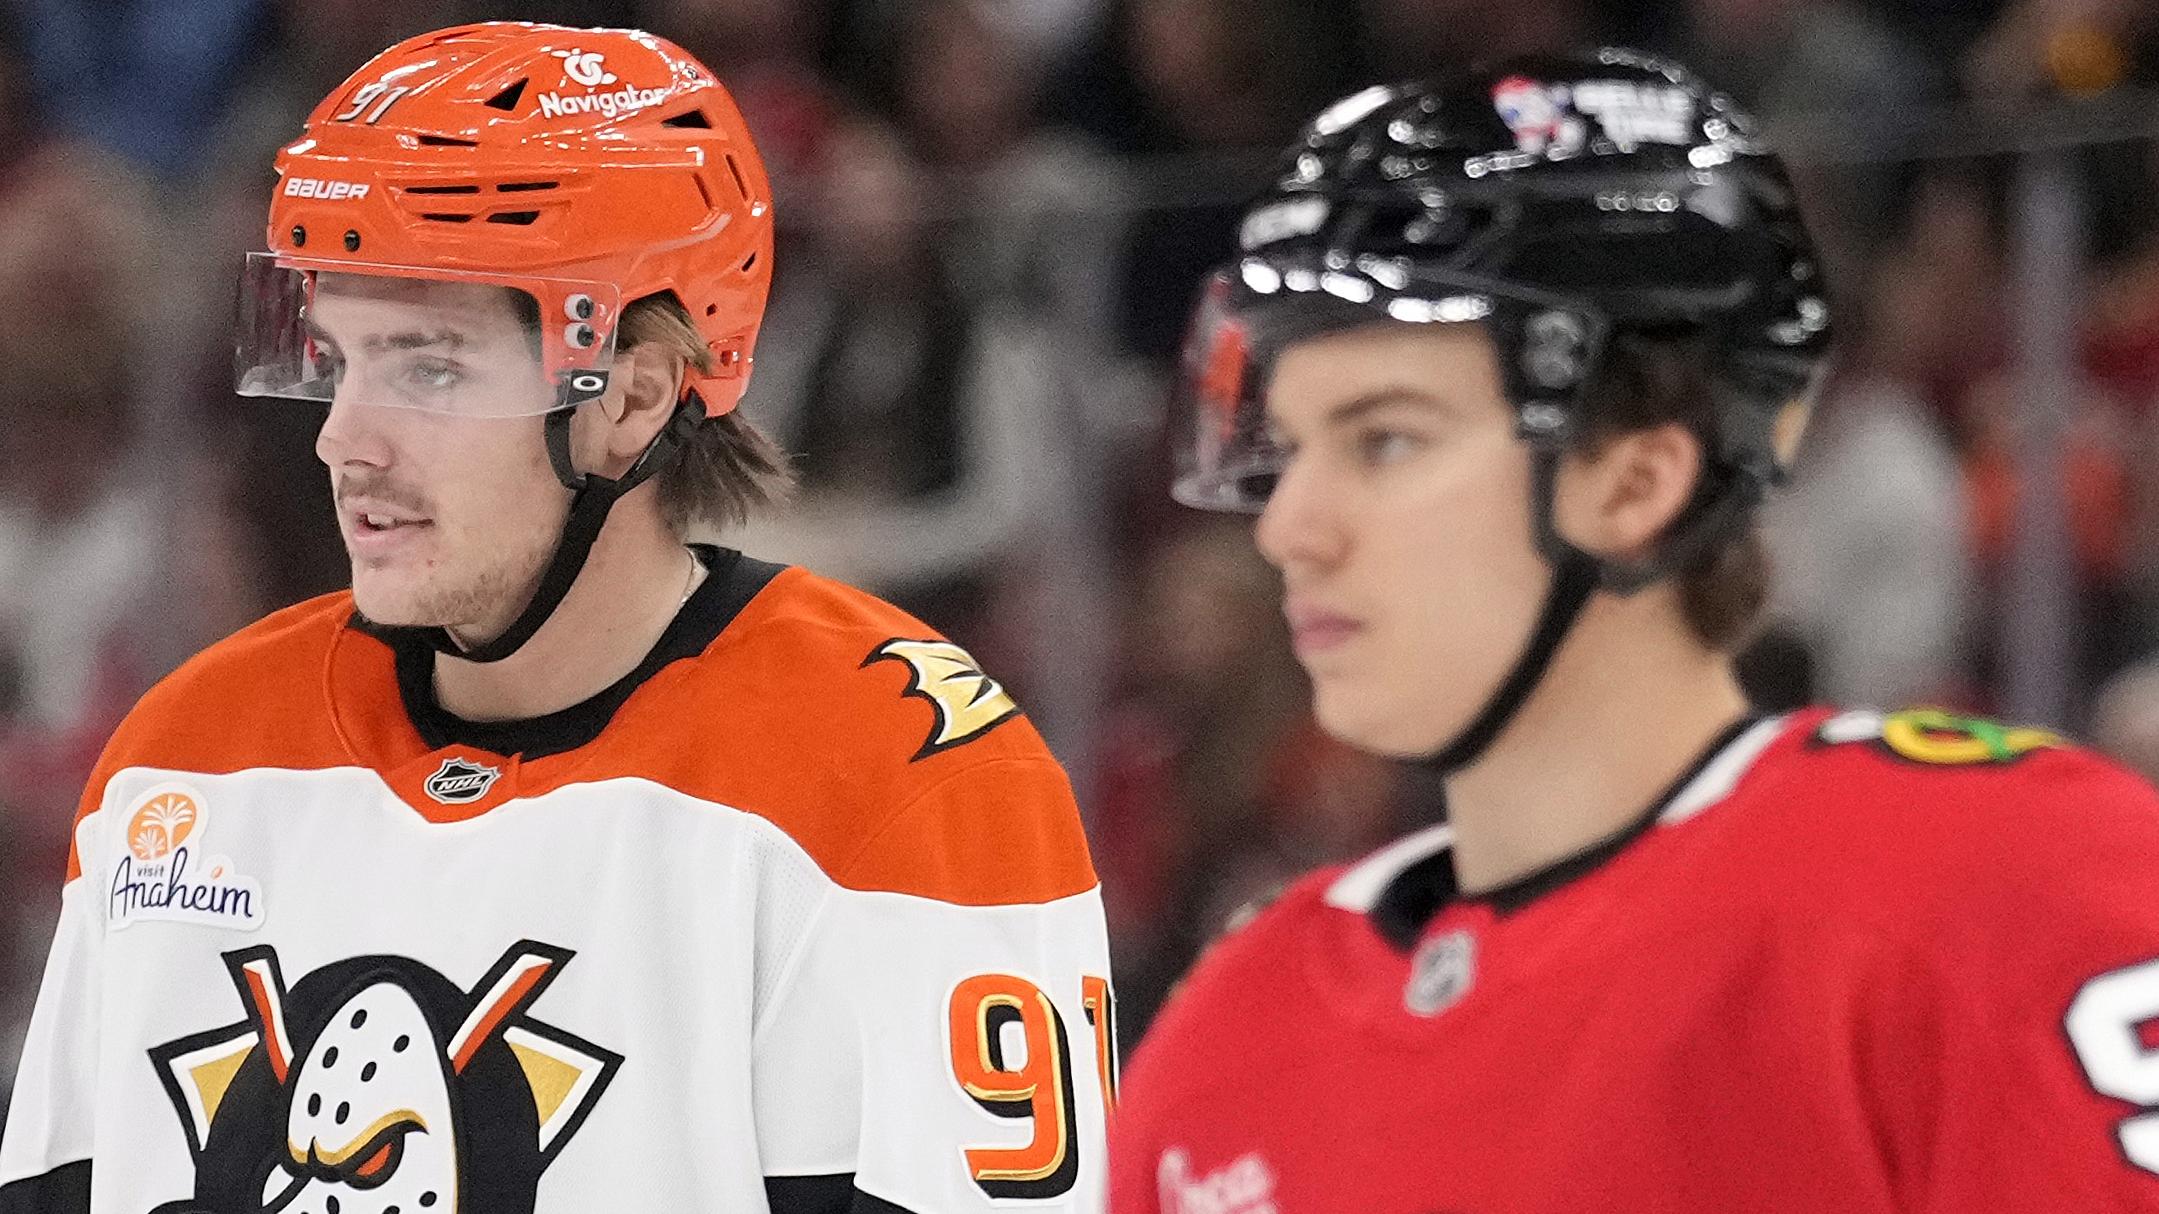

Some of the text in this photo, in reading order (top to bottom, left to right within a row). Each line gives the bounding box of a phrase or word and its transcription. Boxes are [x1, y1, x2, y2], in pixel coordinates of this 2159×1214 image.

[336, 82, 412, 124] 91
[538, 83, 668, 118] Navigator
[284, 177, 370, 200] BAUER
[437, 775, 483, 791] NHL
[110, 847, 253, 920] Anaheim
[136, 864, 164, 878] visit
